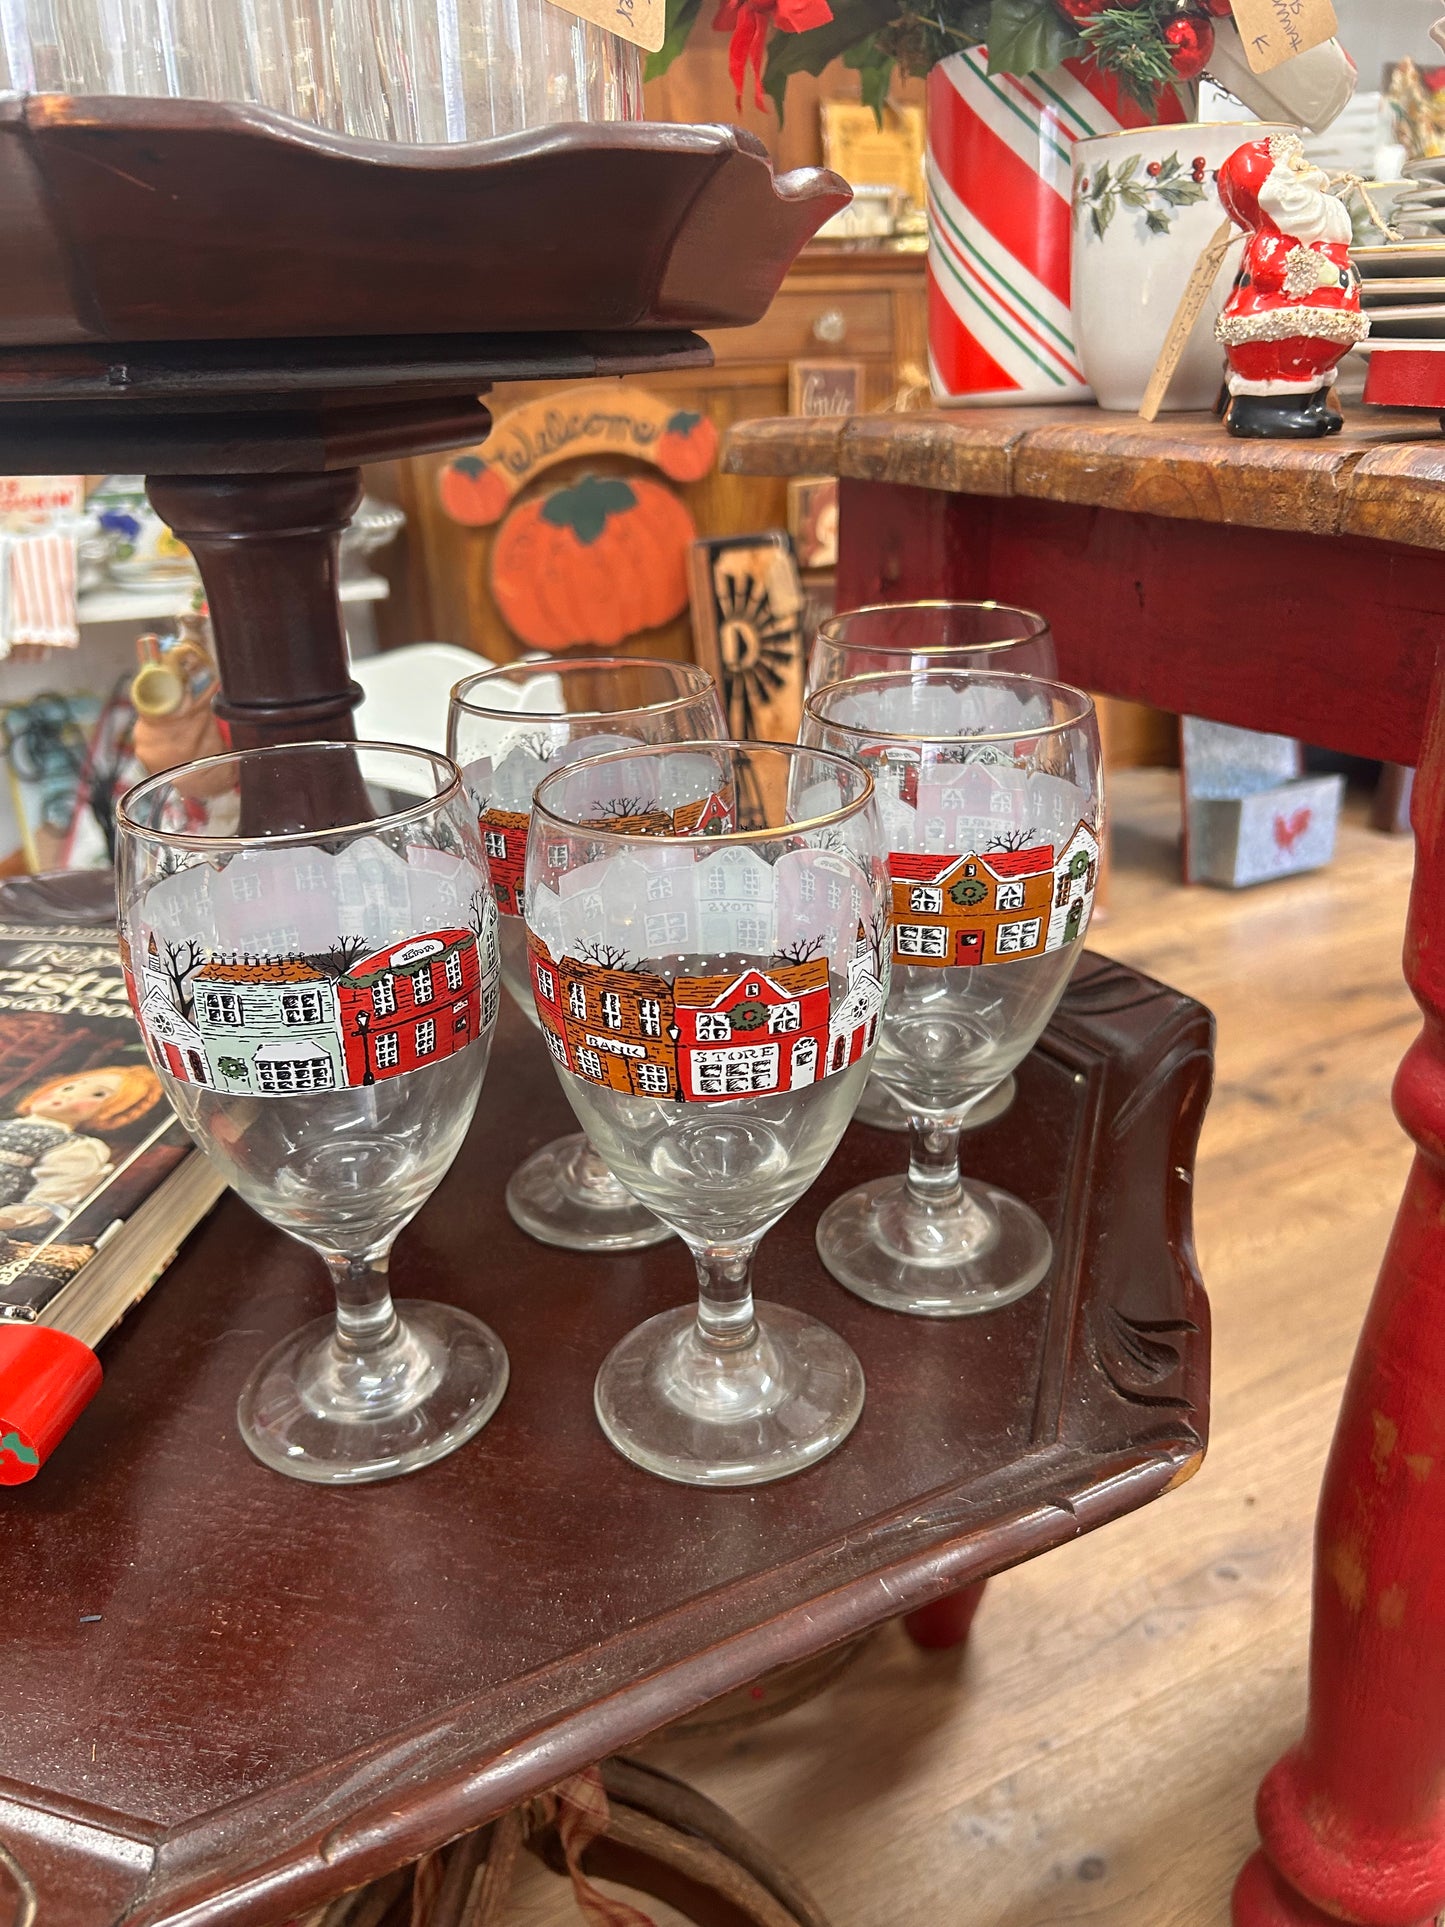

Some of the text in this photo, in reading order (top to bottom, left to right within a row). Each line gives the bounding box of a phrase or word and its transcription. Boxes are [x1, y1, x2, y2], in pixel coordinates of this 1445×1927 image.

[496, 409, 658, 475] Welcome
[588, 1036, 642, 1058] BANK
[693, 1046, 775, 1063] STORE
